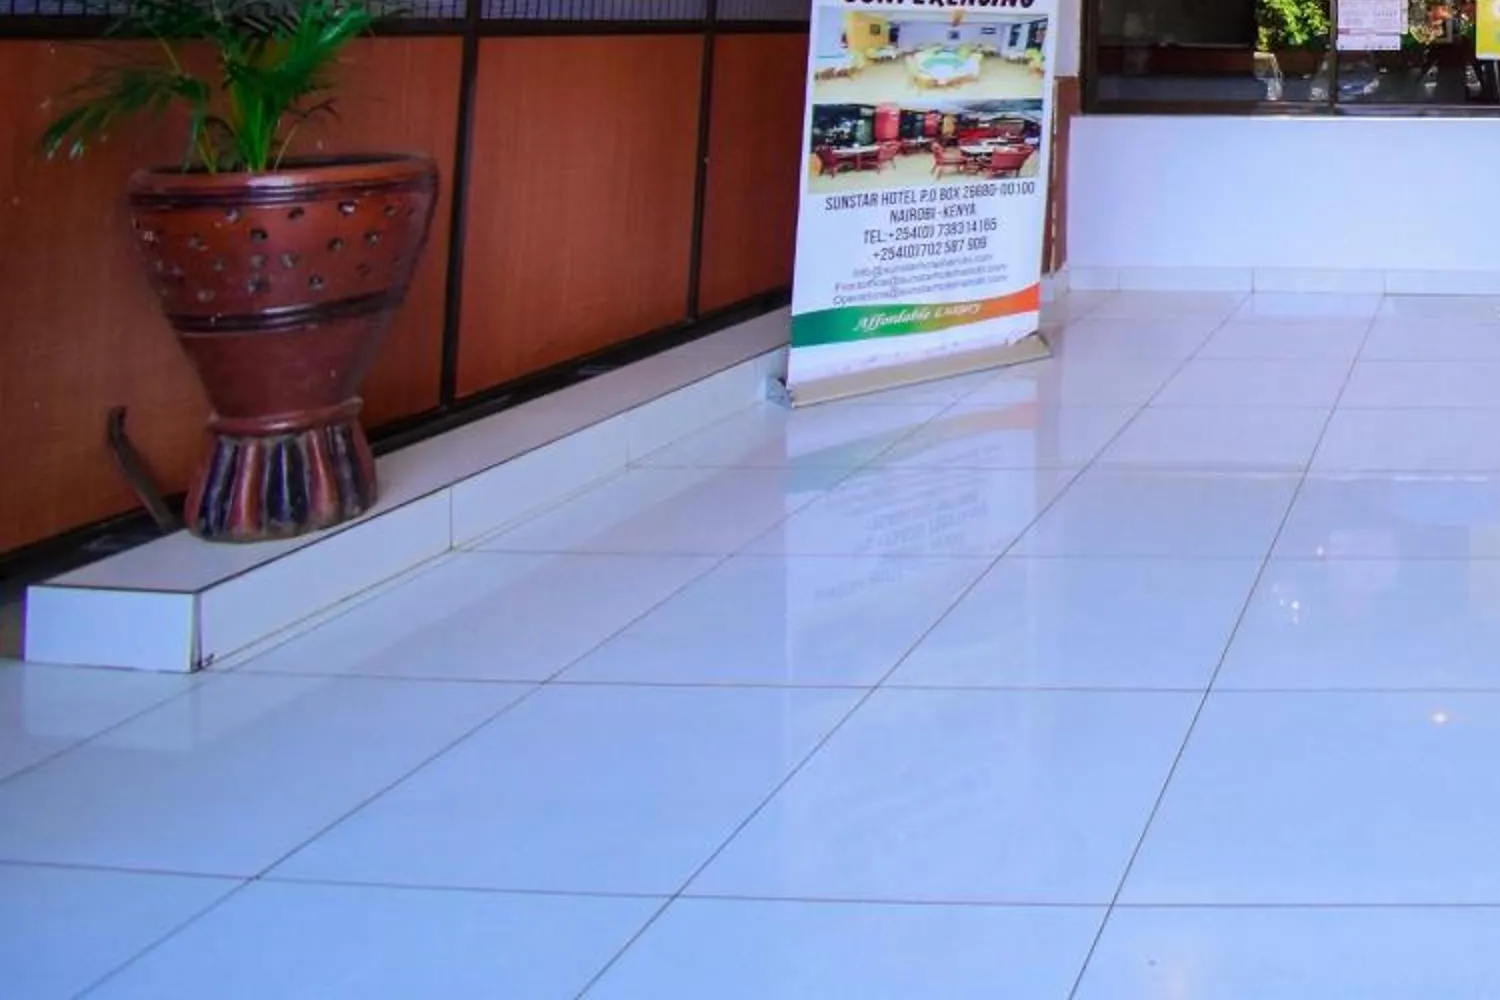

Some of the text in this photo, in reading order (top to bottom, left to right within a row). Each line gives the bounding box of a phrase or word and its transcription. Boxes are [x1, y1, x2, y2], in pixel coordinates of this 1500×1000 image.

[825, 193, 879, 211] SUNSTAR
[881, 189, 917, 206] HOTEL
[940, 186, 960, 201] BOX
